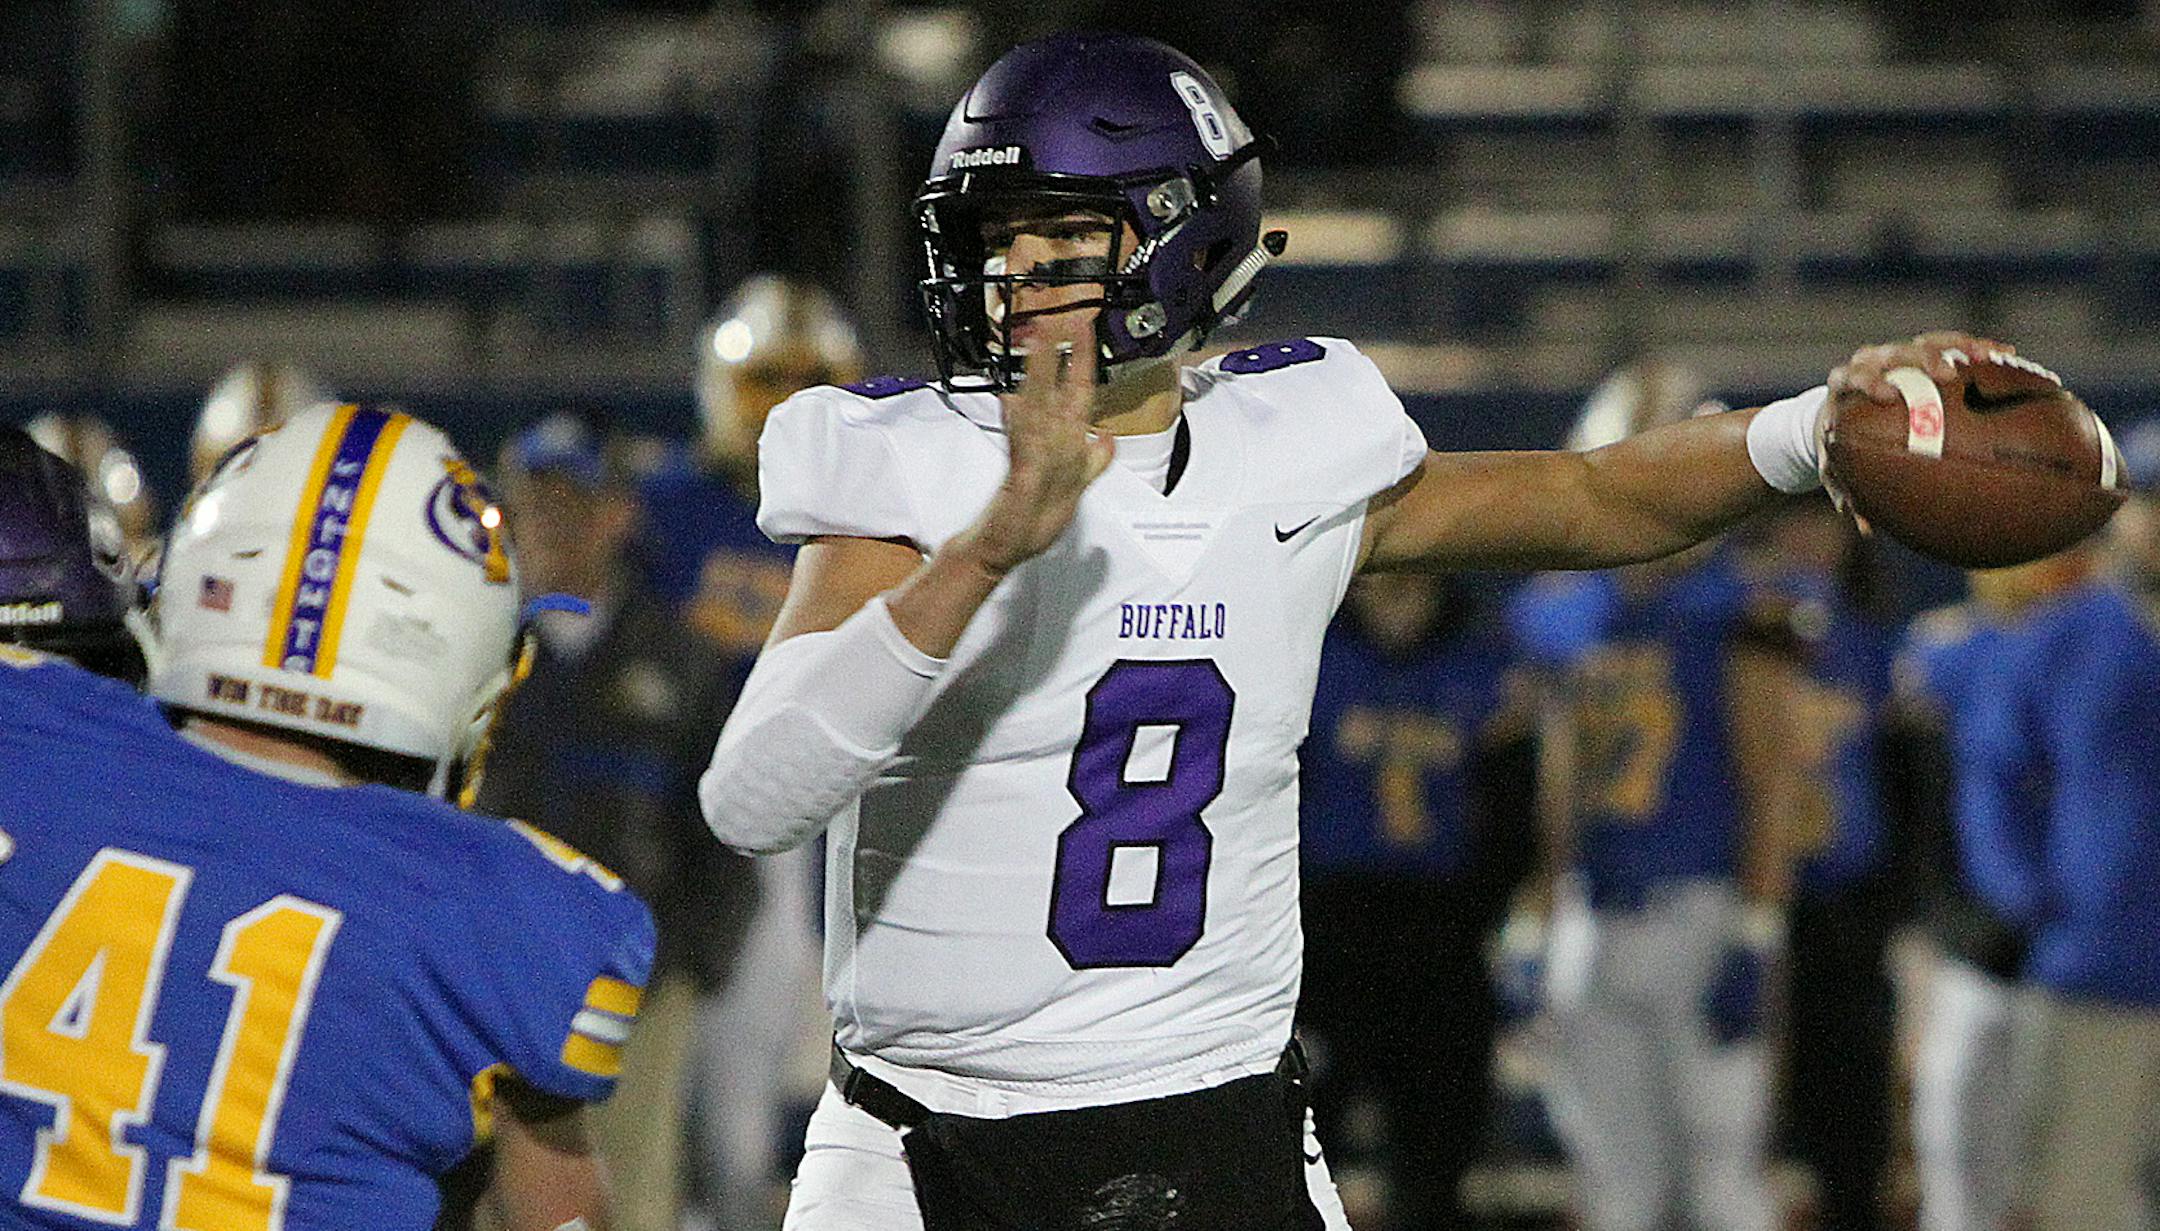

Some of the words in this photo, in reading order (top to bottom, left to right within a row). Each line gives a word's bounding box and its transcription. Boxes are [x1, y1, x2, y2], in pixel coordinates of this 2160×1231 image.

[1169, 71, 1234, 161] 8
[949, 146, 1020, 169] Riddell
[1219, 338, 1327, 375] 8
[1117, 602, 1226, 640] BUFFALO
[1046, 658, 1236, 970] 8
[0, 847, 343, 1231] 41
